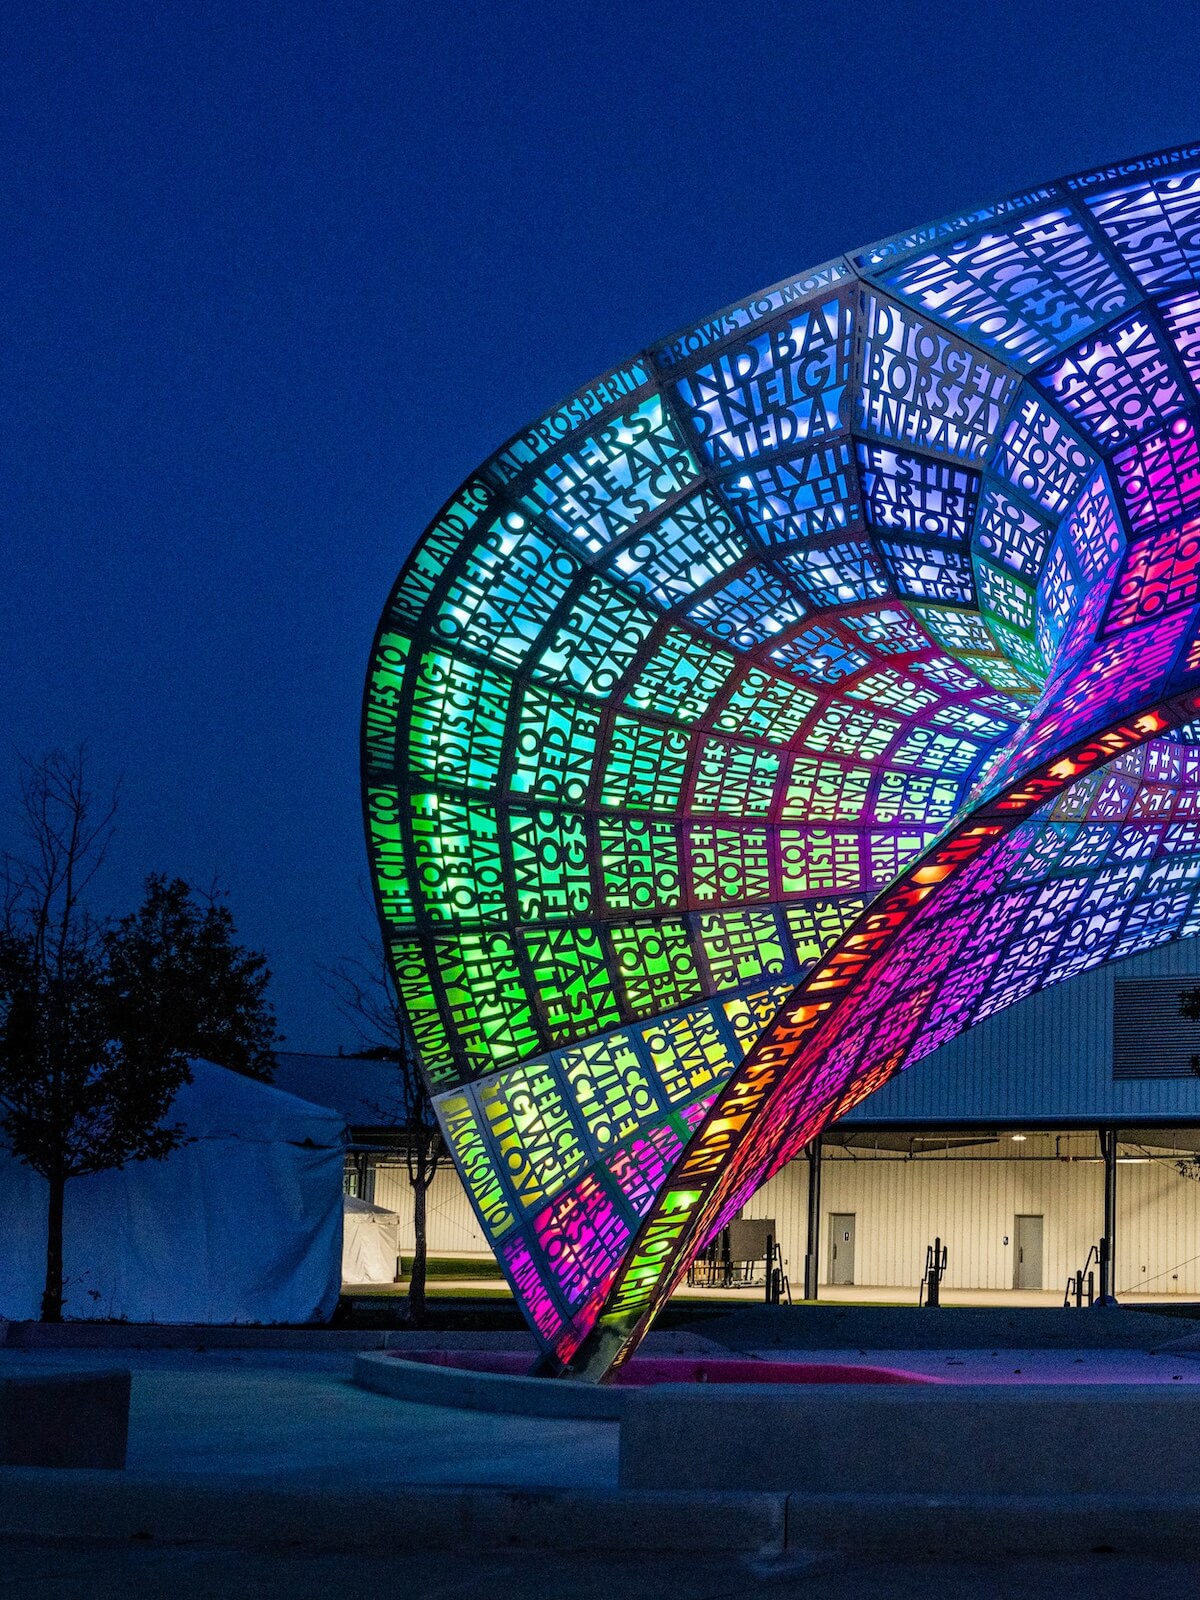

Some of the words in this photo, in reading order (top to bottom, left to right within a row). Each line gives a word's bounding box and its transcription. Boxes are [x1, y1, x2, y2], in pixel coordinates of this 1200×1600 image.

[780, 262, 849, 305] MOVE
[949, 232, 1083, 333] SUCCESS
[743, 295, 772, 324] TO
[655, 312, 739, 368] GROWS
[528, 358, 655, 458] PROSPERITY
[628, 518, 673, 563] OF
[986, 490, 1024, 523] SO
[744, 481, 803, 522] MY
[425, 518, 470, 567] AND
[512, 549, 581, 632] WHO
[376, 645, 407, 677] TO
[561, 748, 595, 803] ON
[978, 533, 1013, 566] OF
[410, 804, 453, 921] PEOPLE
[447, 527, 506, 610] HELP
[442, 714, 472, 740] IS
[469, 723, 503, 767] MY
[371, 834, 407, 881] CITY
[443, 838, 475, 878] BE
[471, 829, 508, 923] ABOVE
[380, 886, 416, 923] THE
[447, 884, 481, 926] TO
[749, 911, 783, 948] MY
[637, 926, 663, 958] TO
[652, 973, 678, 1010] BE
[661, 922, 703, 1002] FROM
[724, 911, 762, 974] THE
[391, 942, 435, 1001] FROM
[434, 943, 470, 994] MY
